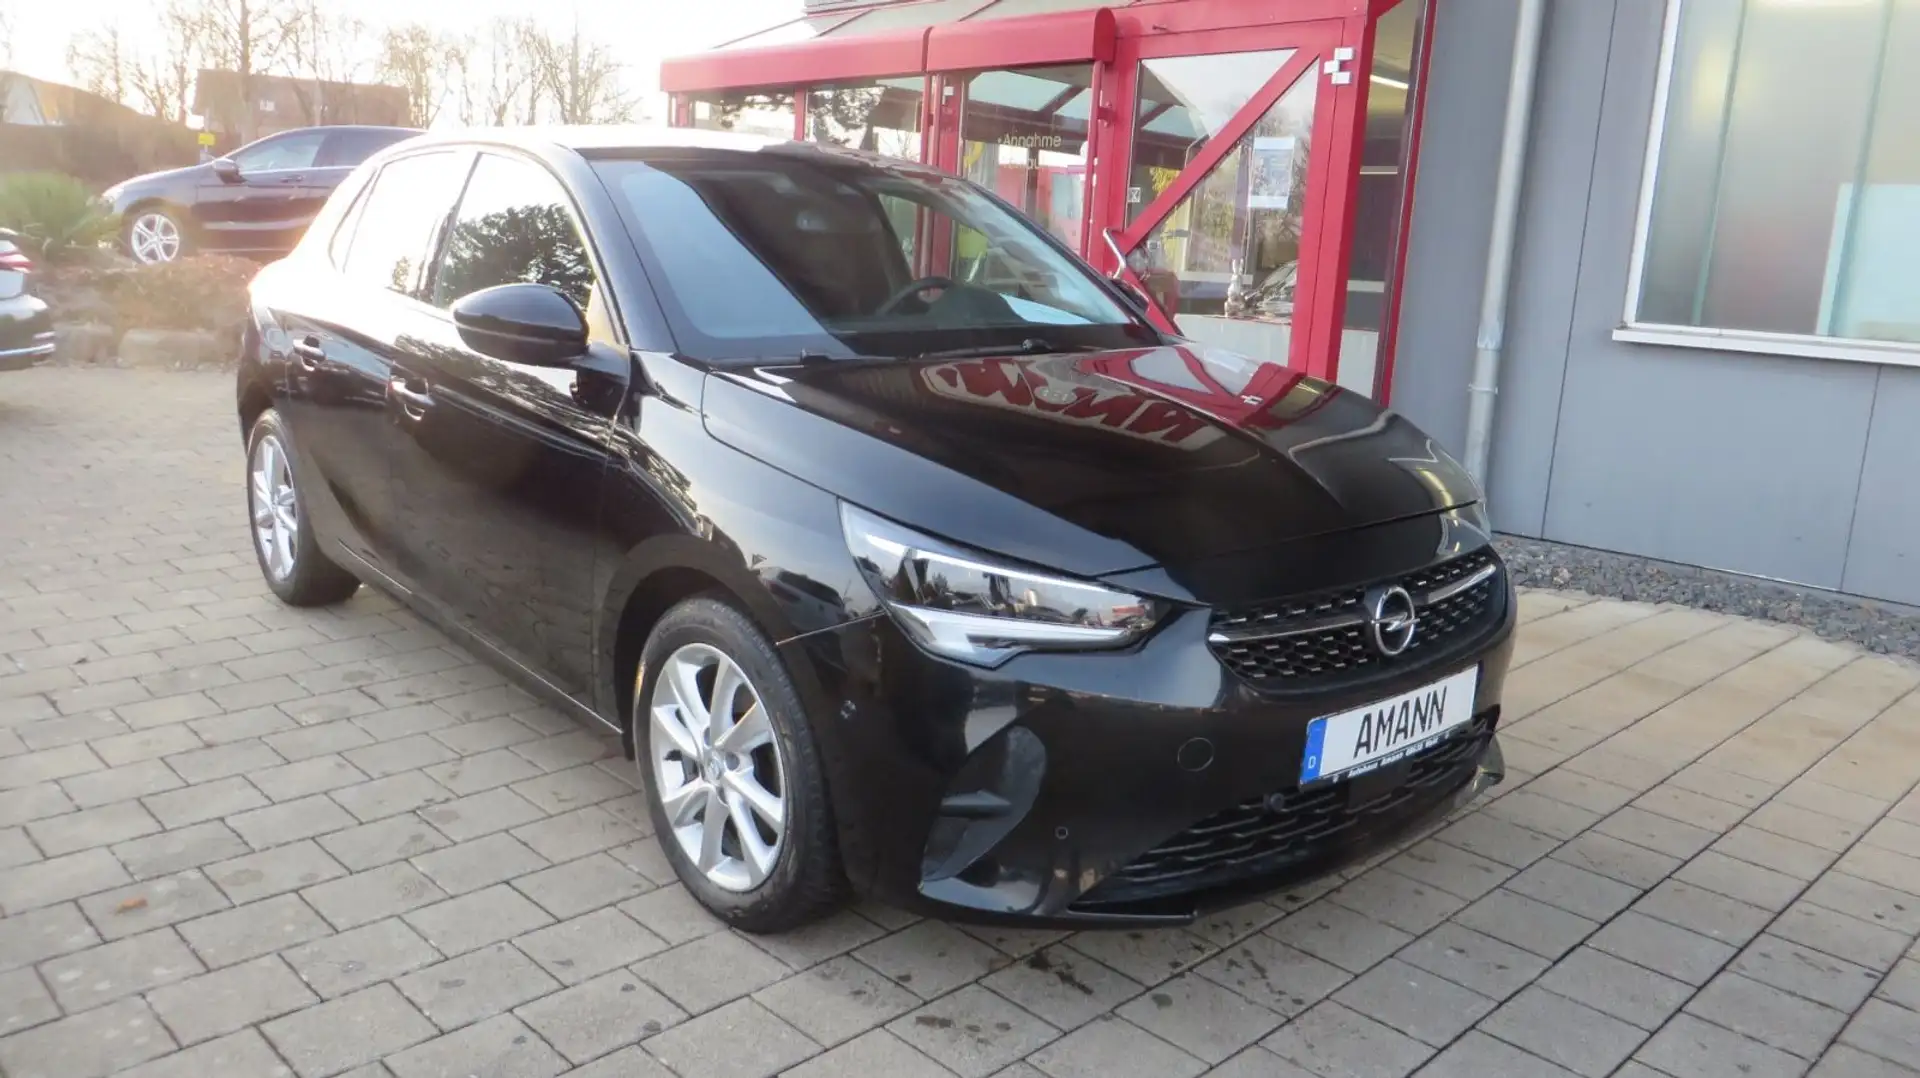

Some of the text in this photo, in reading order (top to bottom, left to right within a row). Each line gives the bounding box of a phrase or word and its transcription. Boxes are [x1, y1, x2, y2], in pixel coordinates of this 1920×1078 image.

[1003, 132, 1062, 148] Annahme
[1353, 685, 1448, 759] AMANN
[1308, 755, 1317, 769] D
